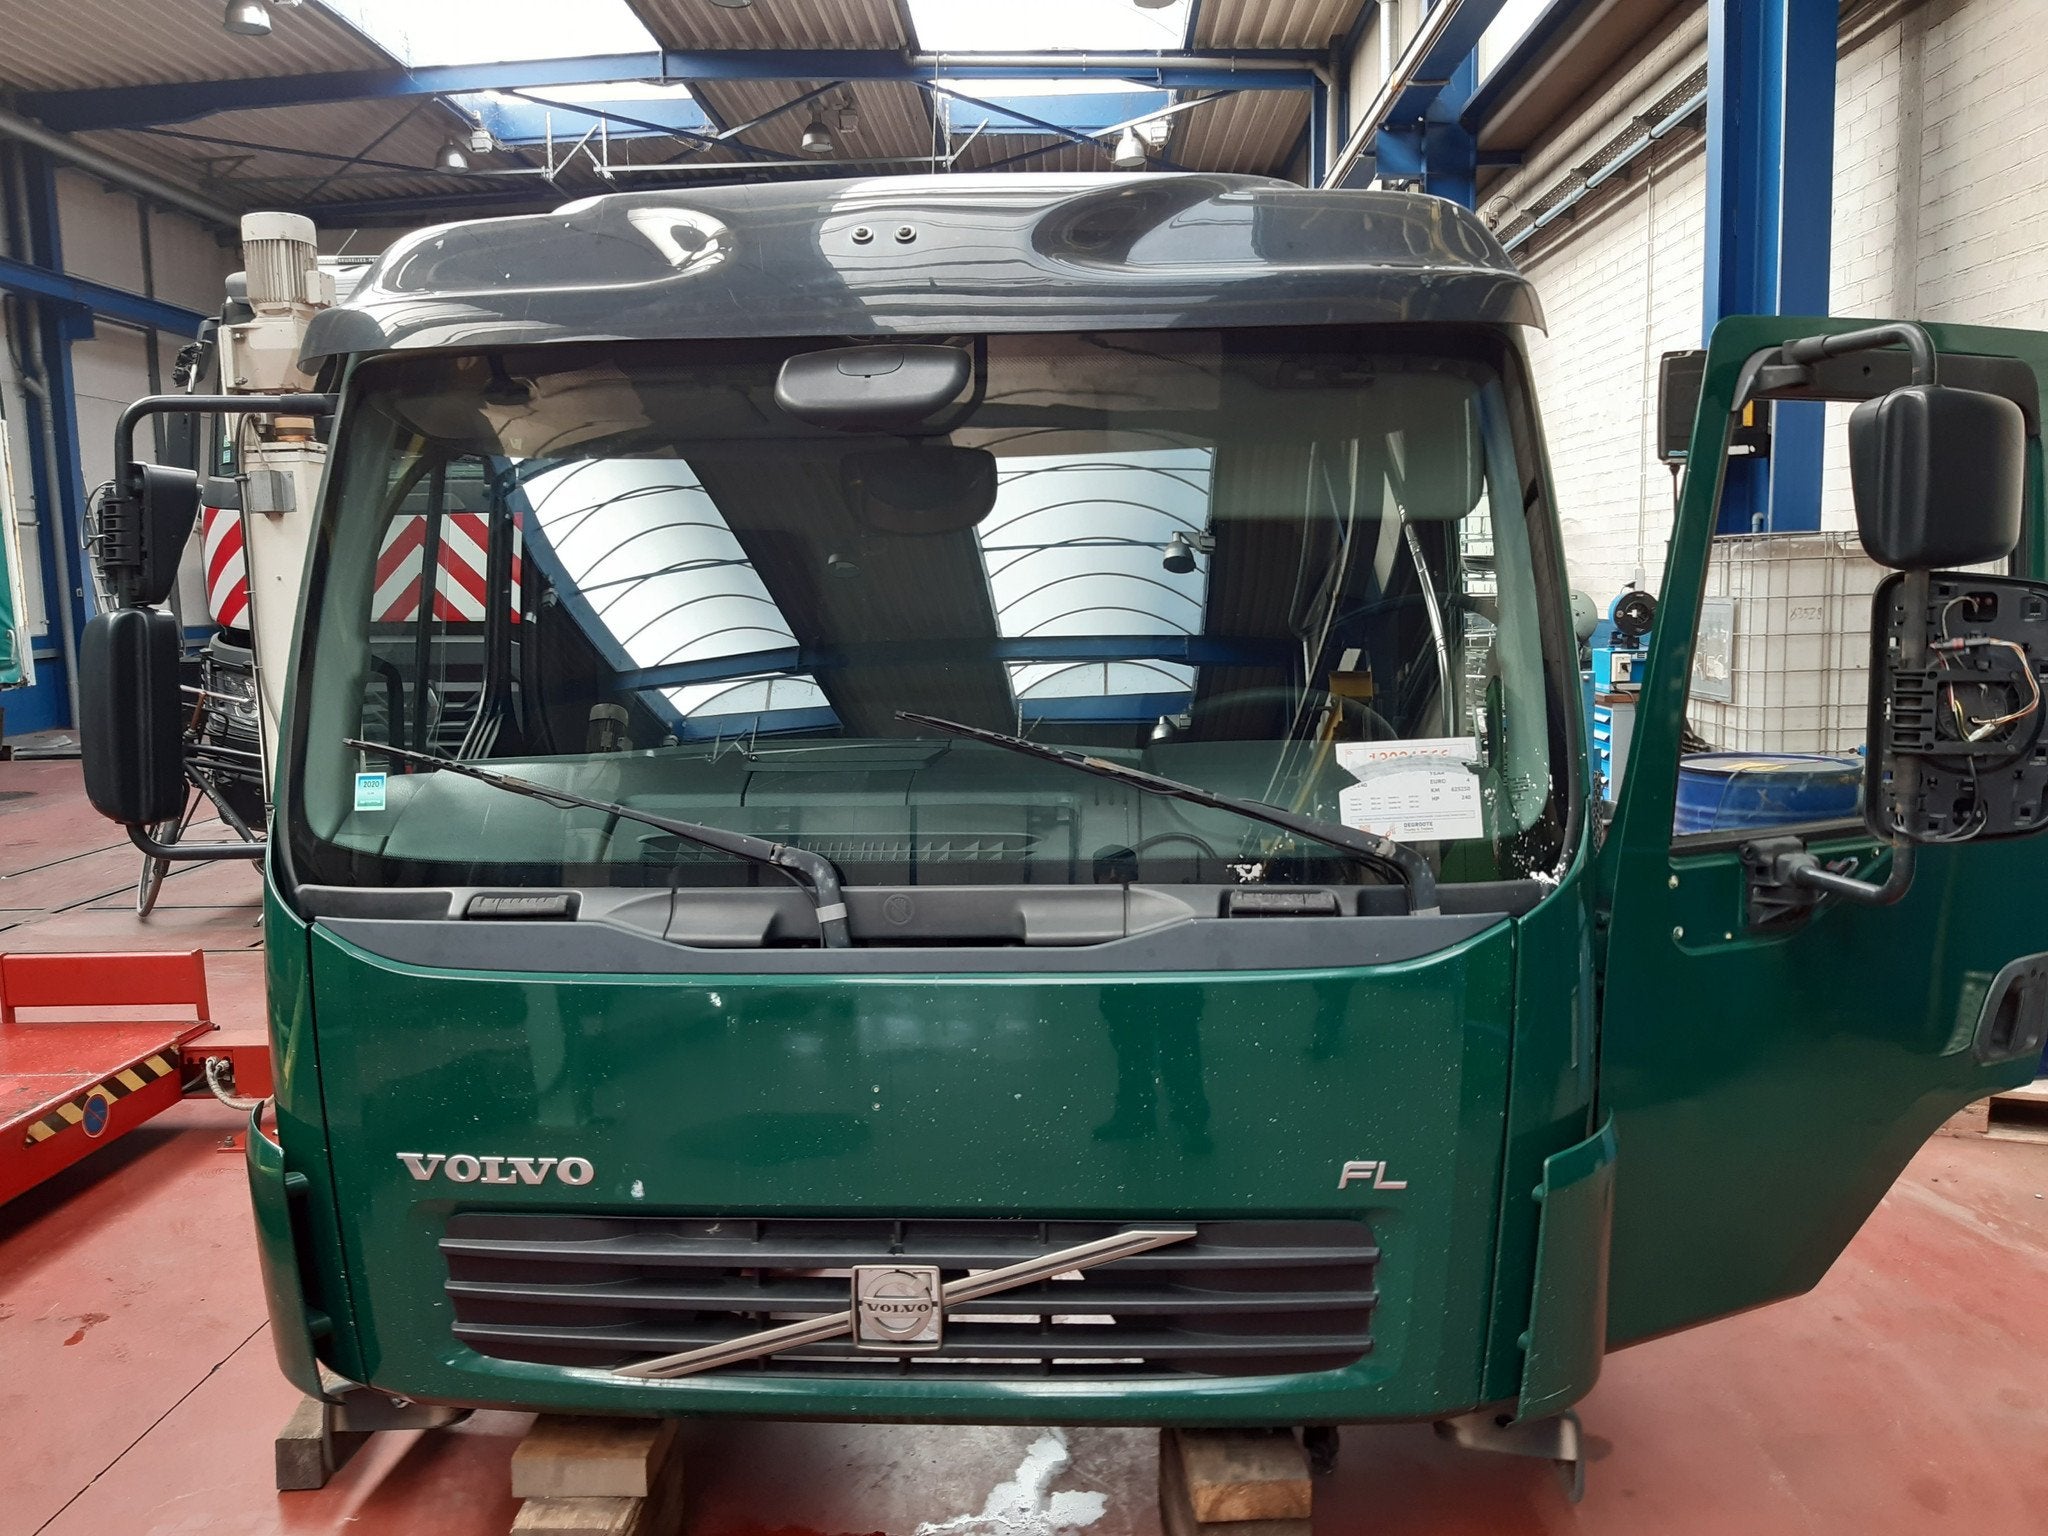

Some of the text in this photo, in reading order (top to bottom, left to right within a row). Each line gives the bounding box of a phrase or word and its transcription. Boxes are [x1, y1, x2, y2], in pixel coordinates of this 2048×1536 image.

[363, 780, 380, 788] 2020
[396, 1152, 595, 1186] VOLVO
[1337, 1160, 1408, 1190] FL
[866, 1303, 929, 1313] VOLVO
